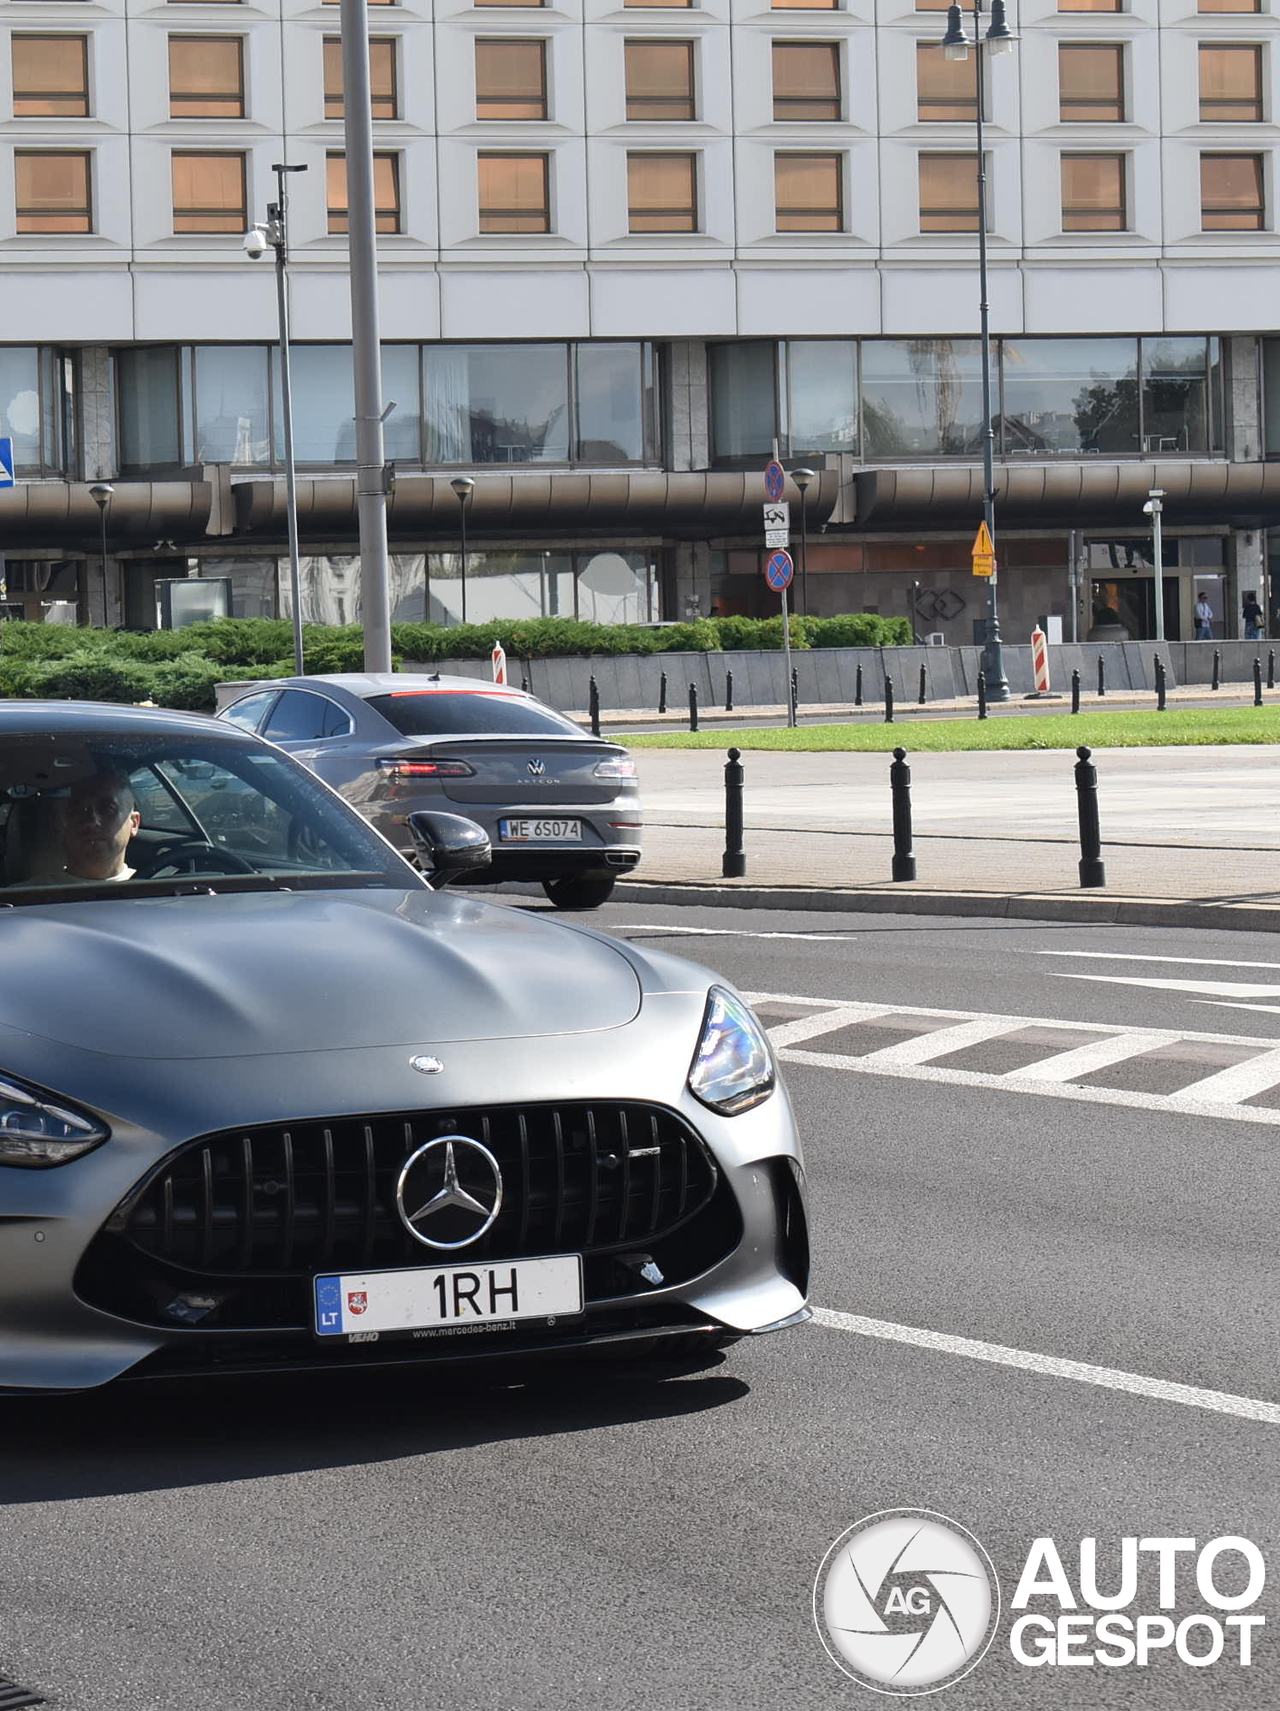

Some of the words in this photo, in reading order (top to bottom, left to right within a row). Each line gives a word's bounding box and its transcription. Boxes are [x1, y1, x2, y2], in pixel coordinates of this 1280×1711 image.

[509, 821, 529, 837] WE
[534, 821, 579, 837] 6S074
[433, 1267, 519, 1319] 1RH
[322, 1312, 338, 1326] LT
[348, 1332, 379, 1343] VEHO
[412, 1320, 517, 1339] www.mercedes-benz.lt
